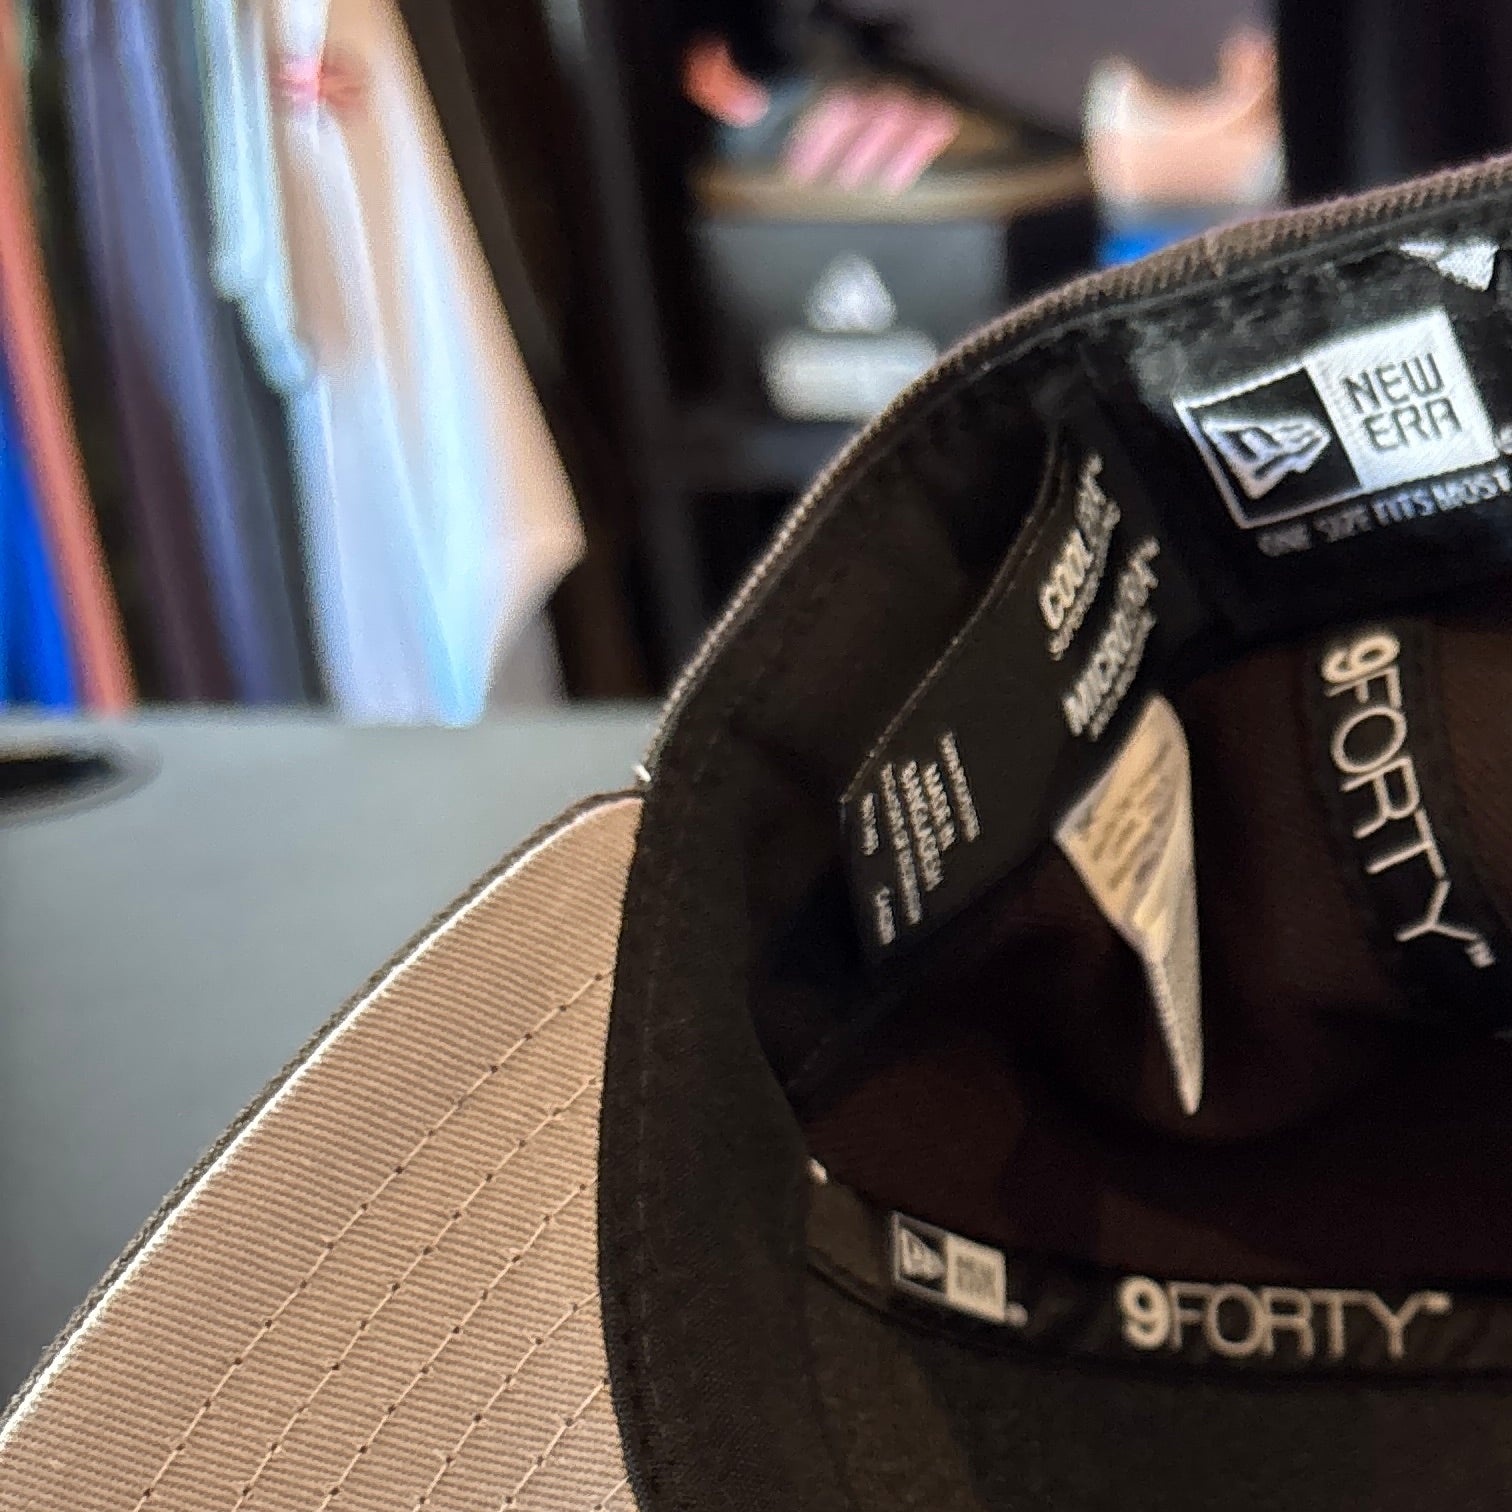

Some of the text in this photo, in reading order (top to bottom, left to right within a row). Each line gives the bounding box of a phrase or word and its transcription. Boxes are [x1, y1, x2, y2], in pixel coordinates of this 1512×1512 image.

[1344, 352, 1445, 411] NEW
[1364, 397, 1464, 451] ERA
[1434, 466, 1512, 512] MOST
[1321, 631, 1484, 945] 9FORTY
[1118, 1275, 1424, 1361] 9FORTY
